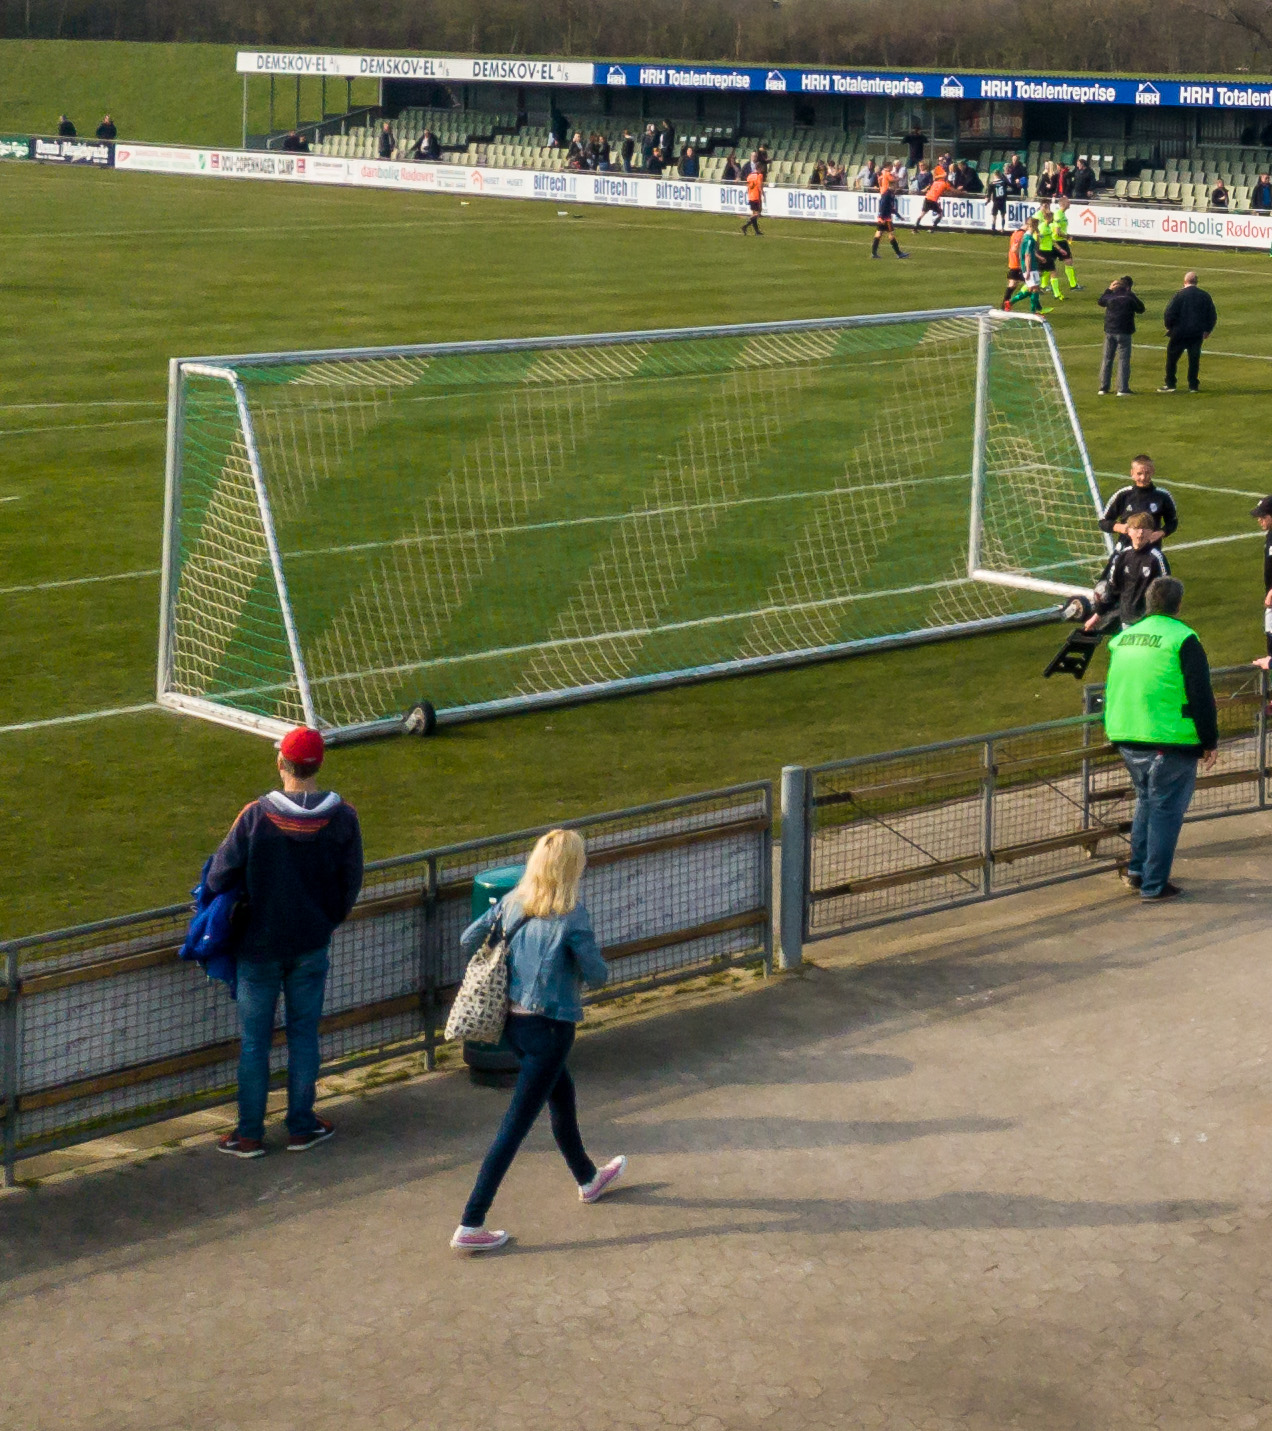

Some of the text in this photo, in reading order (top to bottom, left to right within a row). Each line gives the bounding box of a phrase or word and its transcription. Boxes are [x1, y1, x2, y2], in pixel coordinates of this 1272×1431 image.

[256, 55, 327, 72] DEMSKOV-EL
[360, 58, 435, 76] DEMSKOV-EL
[472, 61, 554, 80] DEMSKOV-EL
[640, 69, 750, 89] HRH Totalentreprise
[765, 80, 786, 91] HRH
[802, 74, 923, 96] HRH Totalentreprise
[941, 86, 964, 98] HRH
[981, 80, 1116, 103] HRH Totalentreprise
[1136, 93, 1160, 105] HRH
[1180, 86, 1213, 104] HRH
[1162, 216, 1223, 237] danbolig
[1226, 221, 1272, 239] Rødovr
[1117, 633, 1163, 649] KONTROL
